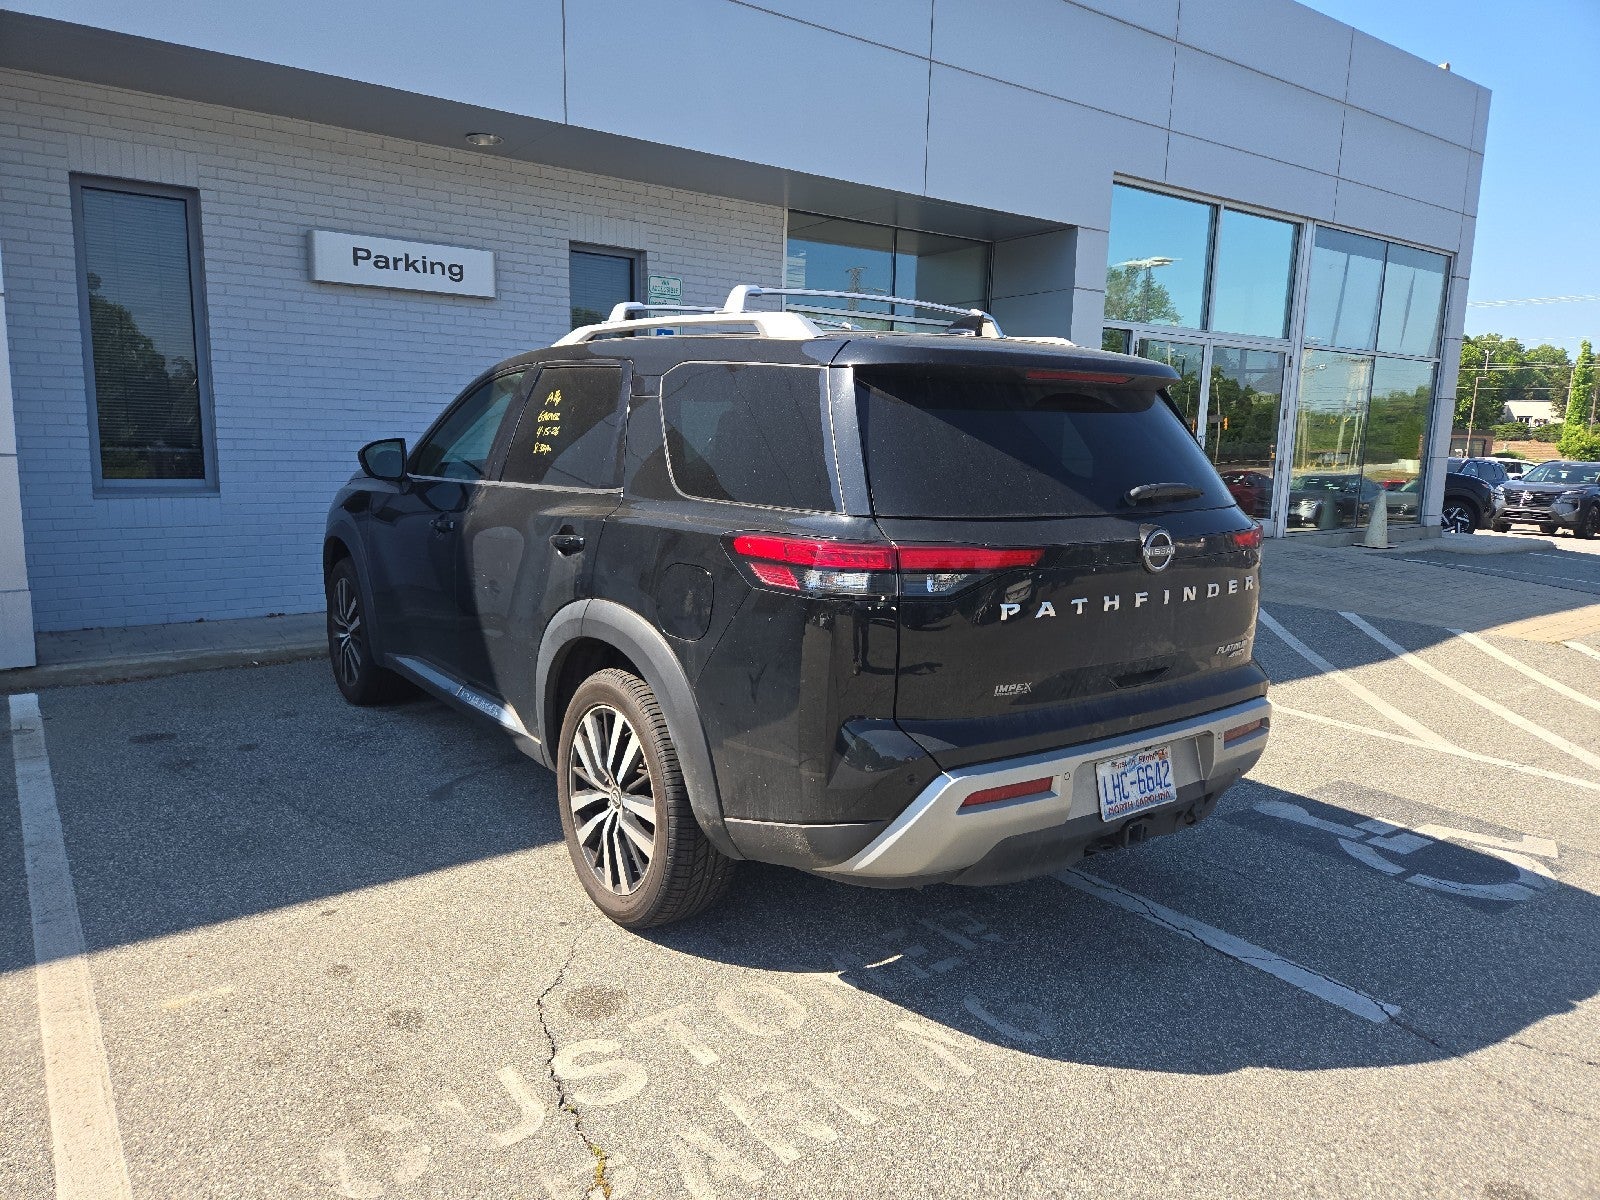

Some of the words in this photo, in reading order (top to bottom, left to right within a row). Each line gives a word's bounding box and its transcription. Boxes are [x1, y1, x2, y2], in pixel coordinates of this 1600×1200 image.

[352, 246, 464, 282] Parking
[1143, 545, 1175, 557] NISSAN
[1000, 575, 1254, 621] PATHFINDER
[1216, 640, 1248, 655] PLATINUM
[994, 681, 1033, 695] IMPEX
[1102, 759, 1172, 806] LHC-6642
[1108, 800, 1134, 815] NORTH
[1135, 790, 1171, 807] CAROLINA
